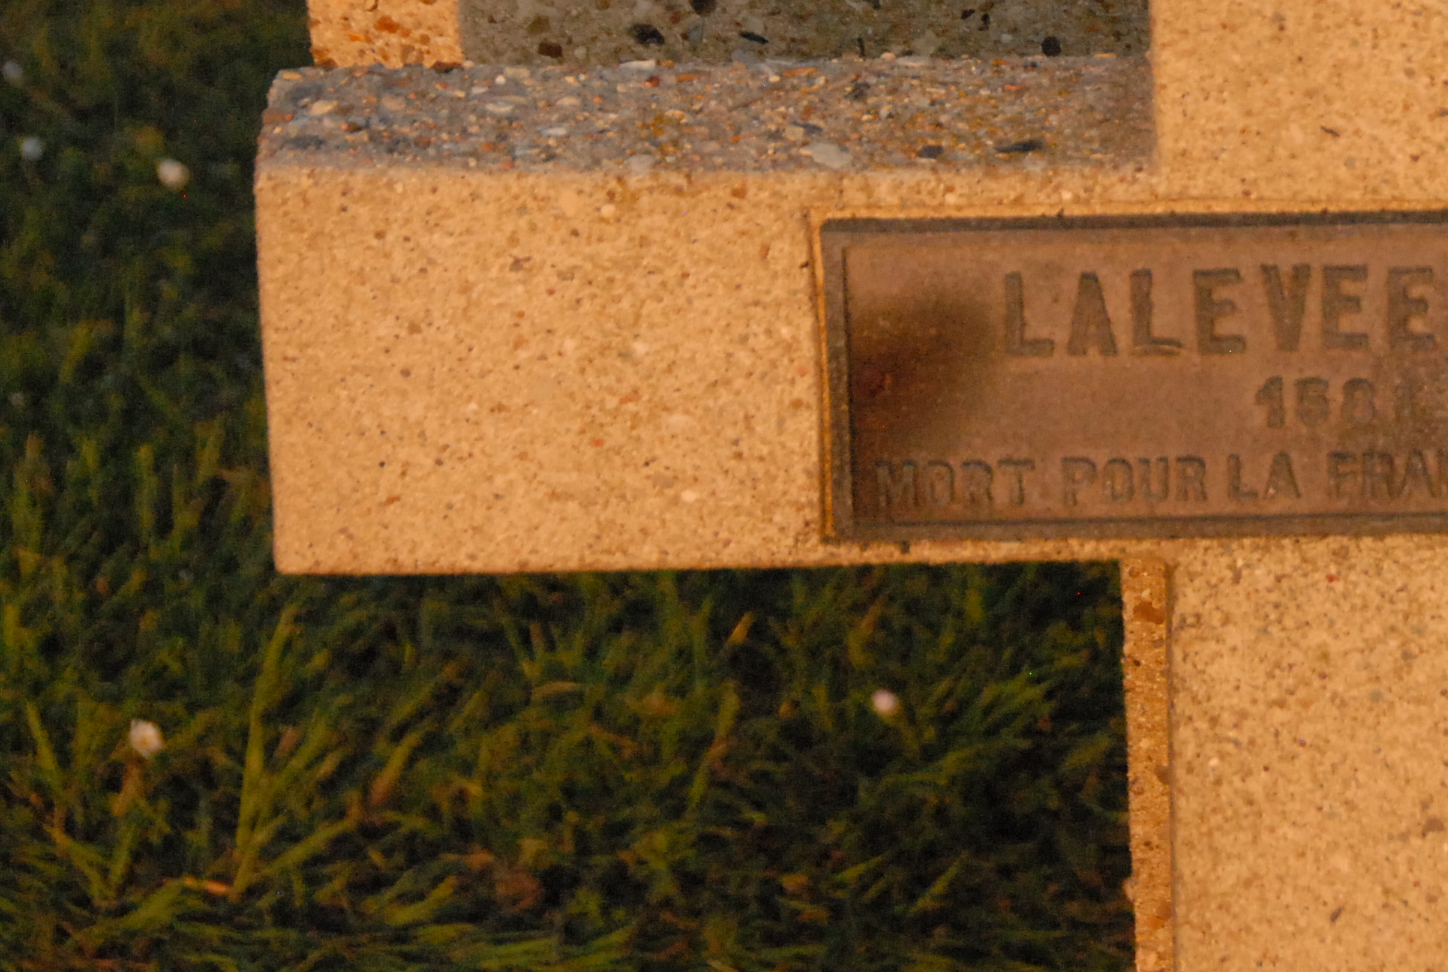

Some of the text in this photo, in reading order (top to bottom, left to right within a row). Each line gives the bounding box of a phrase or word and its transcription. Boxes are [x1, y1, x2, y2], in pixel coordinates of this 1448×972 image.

[1007, 264, 1440, 358] LALEVEE
[875, 459, 1037, 507] MORT
[1061, 455, 1208, 504] POUR
[1228, 452, 1302, 500] LA
